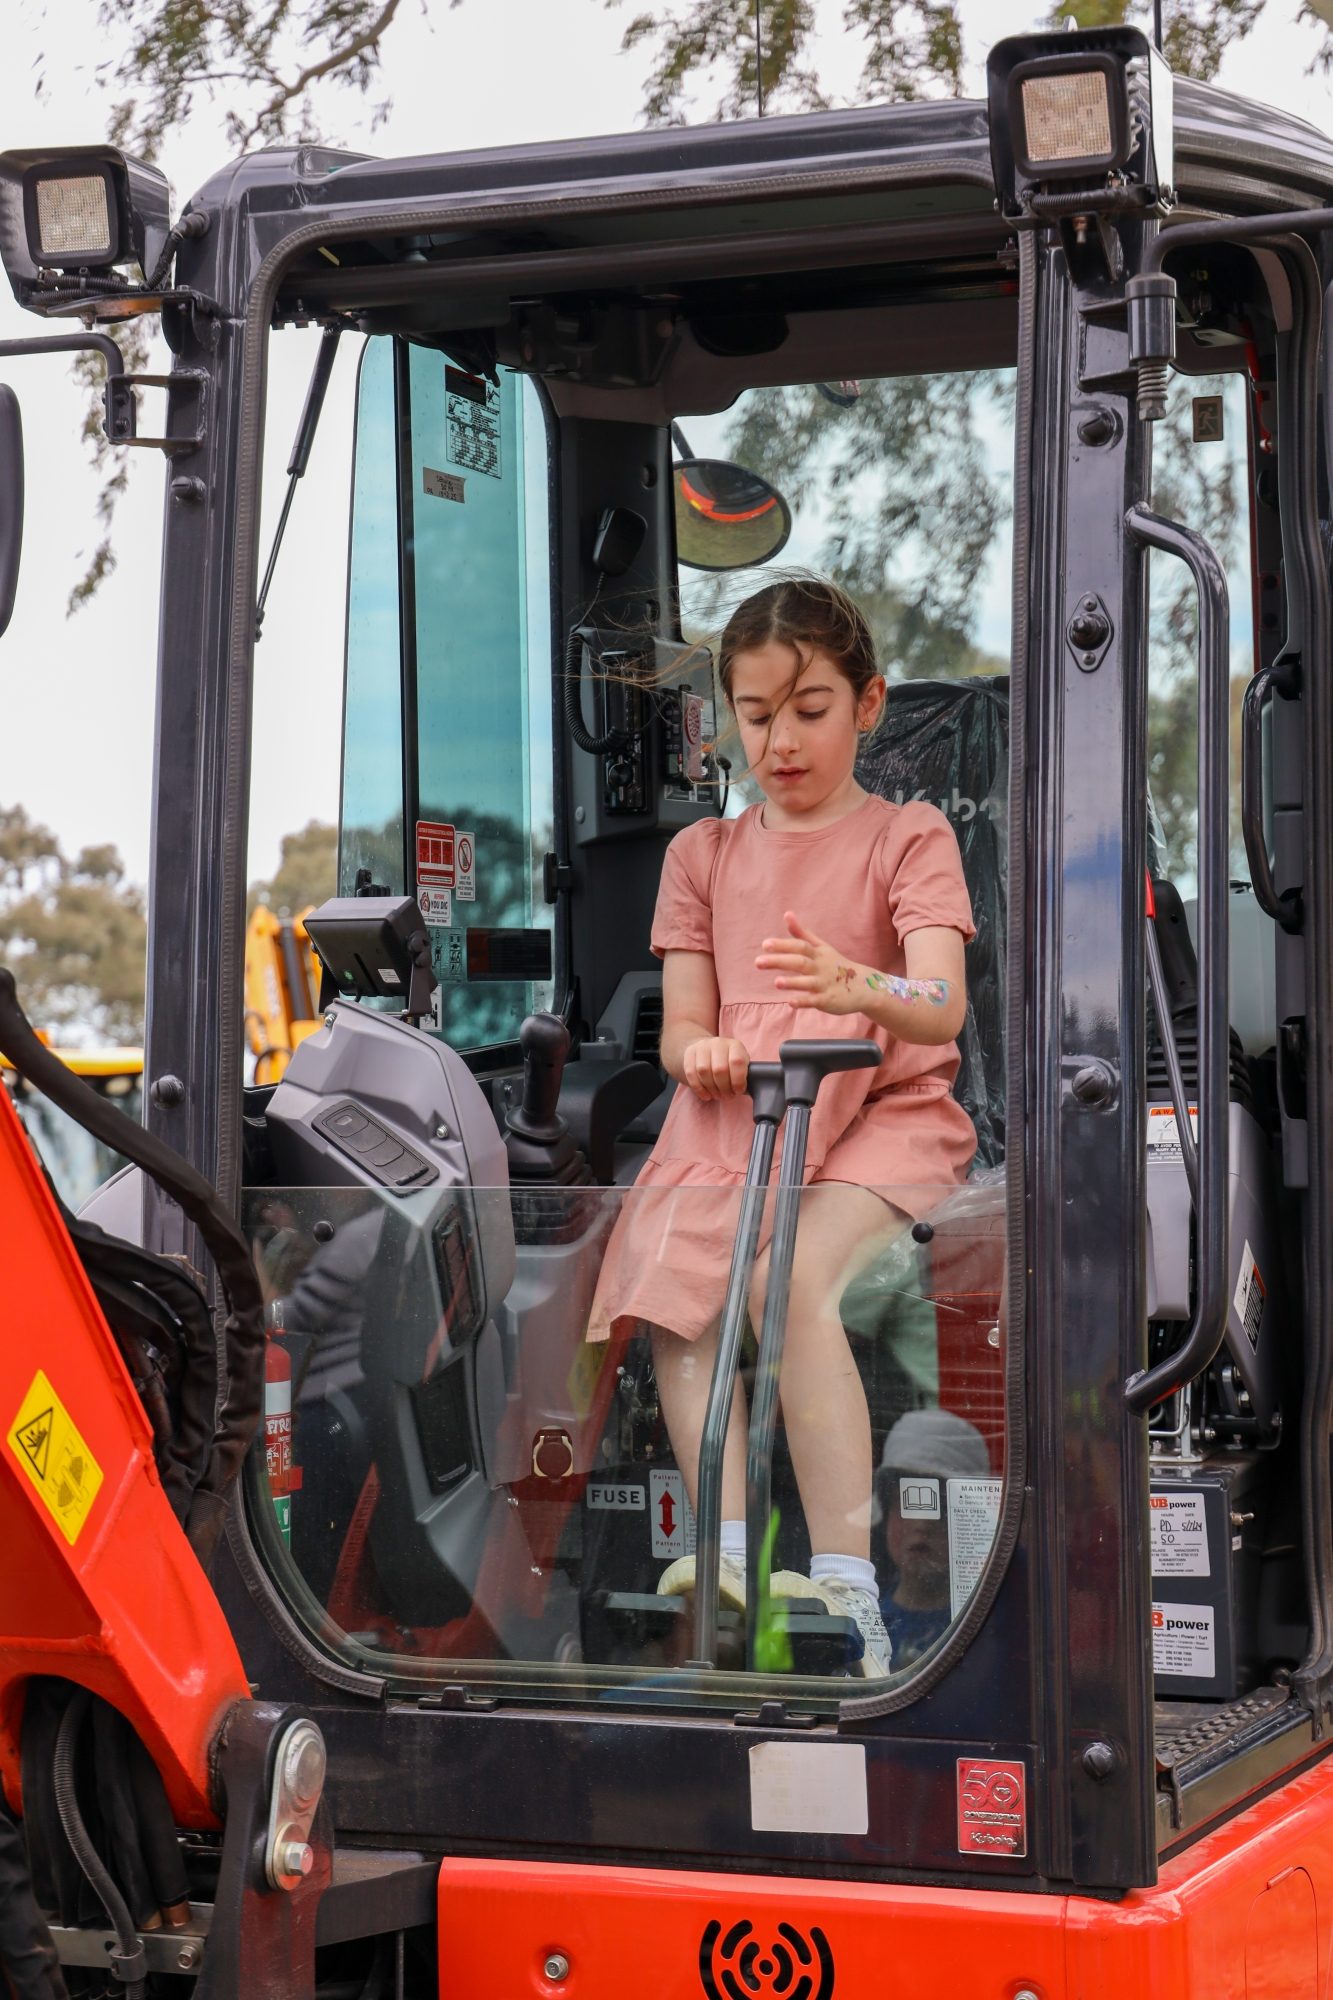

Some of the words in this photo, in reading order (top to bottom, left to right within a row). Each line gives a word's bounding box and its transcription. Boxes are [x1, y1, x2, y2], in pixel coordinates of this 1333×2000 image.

[431, 901, 440, 909] YOU
[591, 1489, 640, 1504] FUSE
[1166, 1619, 1209, 1631] power
[963, 1770, 1020, 1809] 50
[964, 1811, 1021, 1820] CONSTRUCTION
[971, 1832, 1017, 1847] Kubota
